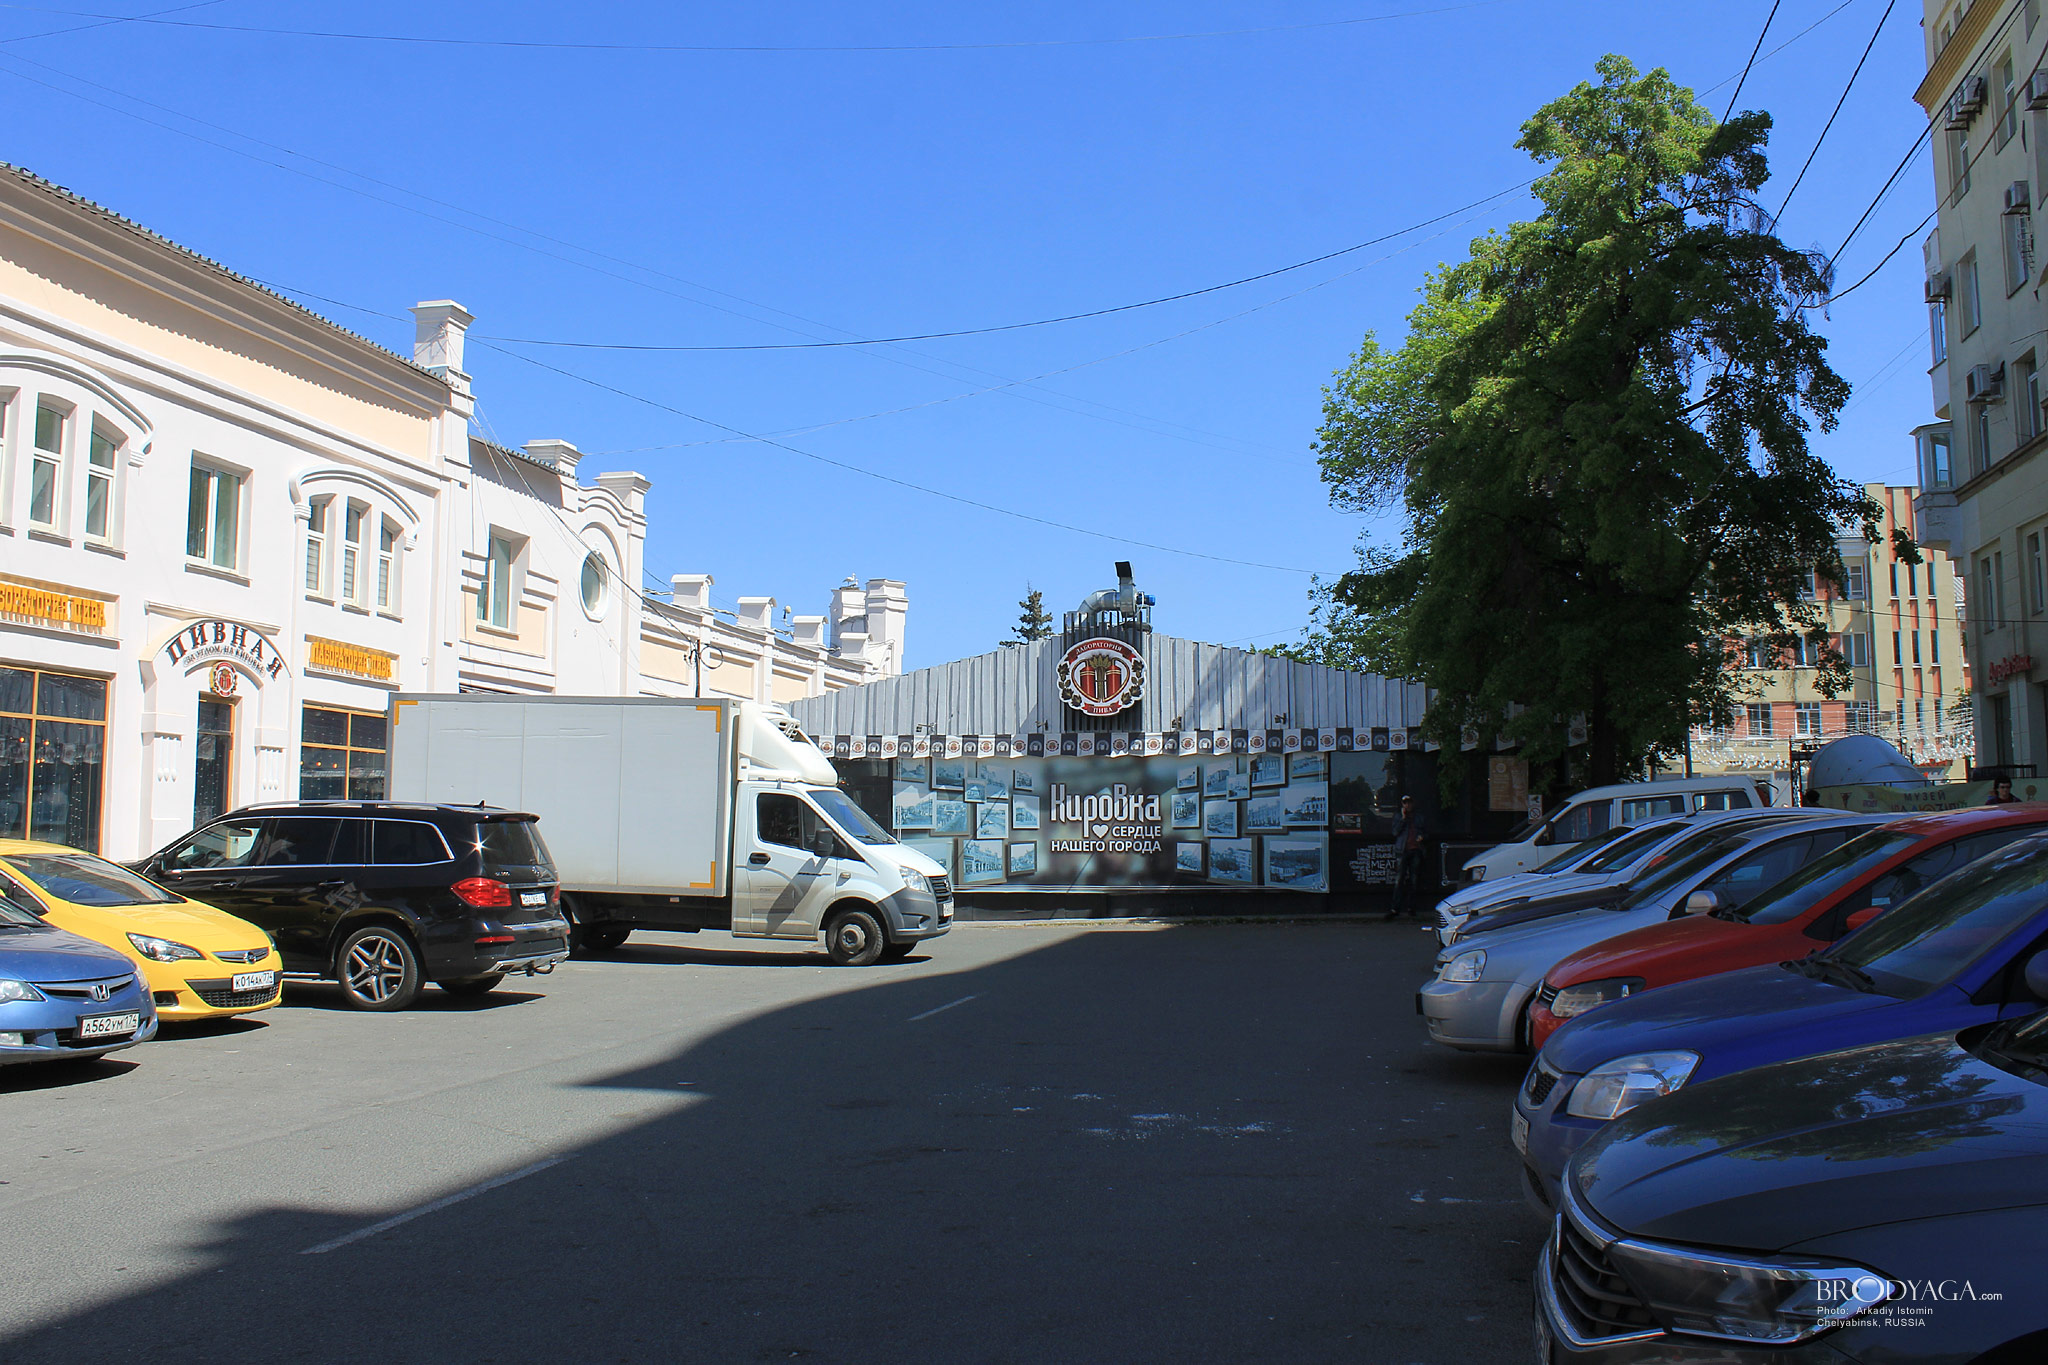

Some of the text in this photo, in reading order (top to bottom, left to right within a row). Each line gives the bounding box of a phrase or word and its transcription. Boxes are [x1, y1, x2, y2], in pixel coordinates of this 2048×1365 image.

[70, 597, 106, 627] ПИВА
[165, 622, 283, 682] ПИВНАЯ
[1075, 642, 1122, 655] ЛАБОРАТОРИЯ
[310, 641, 392, 678] ЛАБОРАТОРИЯ ПИВА
[1904, 790, 1946, 801] МУЗЕЙ
[1112, 826, 1161, 839] СЕРДЦЕ
[1051, 840, 1161, 854] НАШЕГО ГОРОДА
[1371, 860, 1396, 869] MEAT
